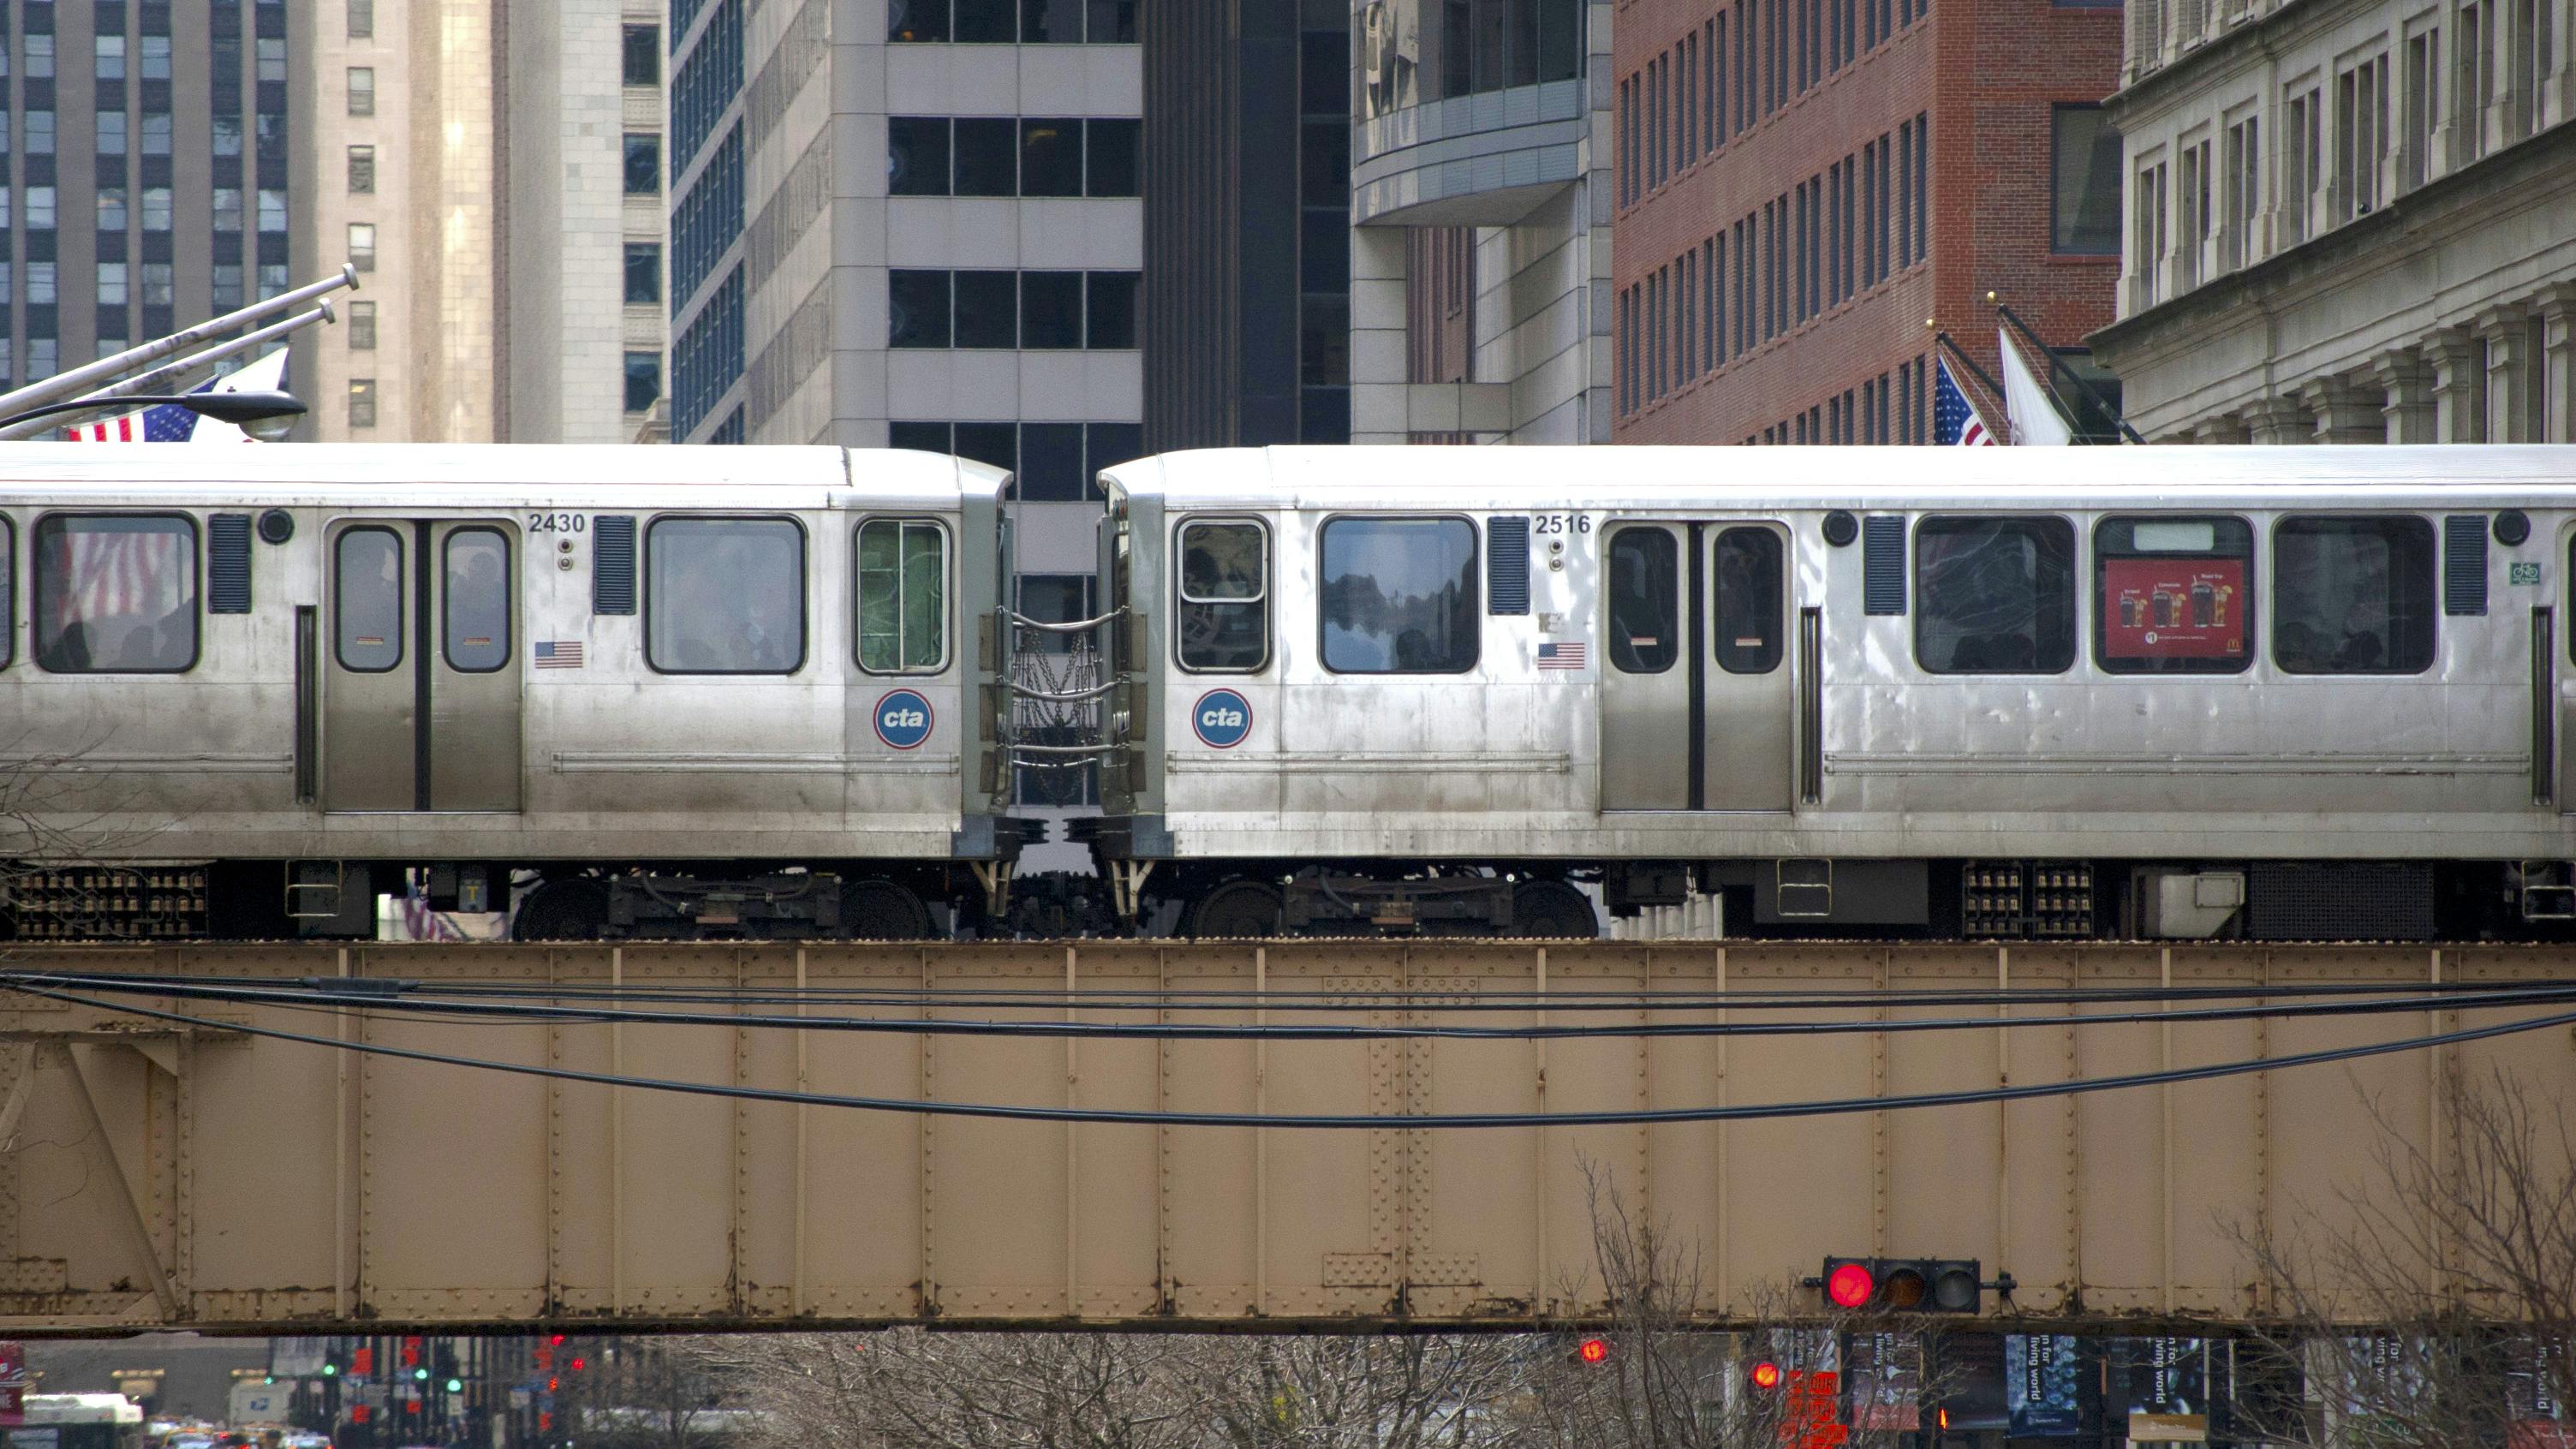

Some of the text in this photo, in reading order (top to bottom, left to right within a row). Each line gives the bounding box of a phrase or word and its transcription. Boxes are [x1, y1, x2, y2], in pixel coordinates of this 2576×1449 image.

[529, 513, 585, 533] 2430
[1535, 515, 1591, 534] 2516
[884, 708, 924, 728] cta
[1202, 707, 1243, 727] cta
[2042, 1347, 2052, 1363] for
[2029, 1337, 2042, 1400] living world
[2156, 1370, 2166, 1404] world
